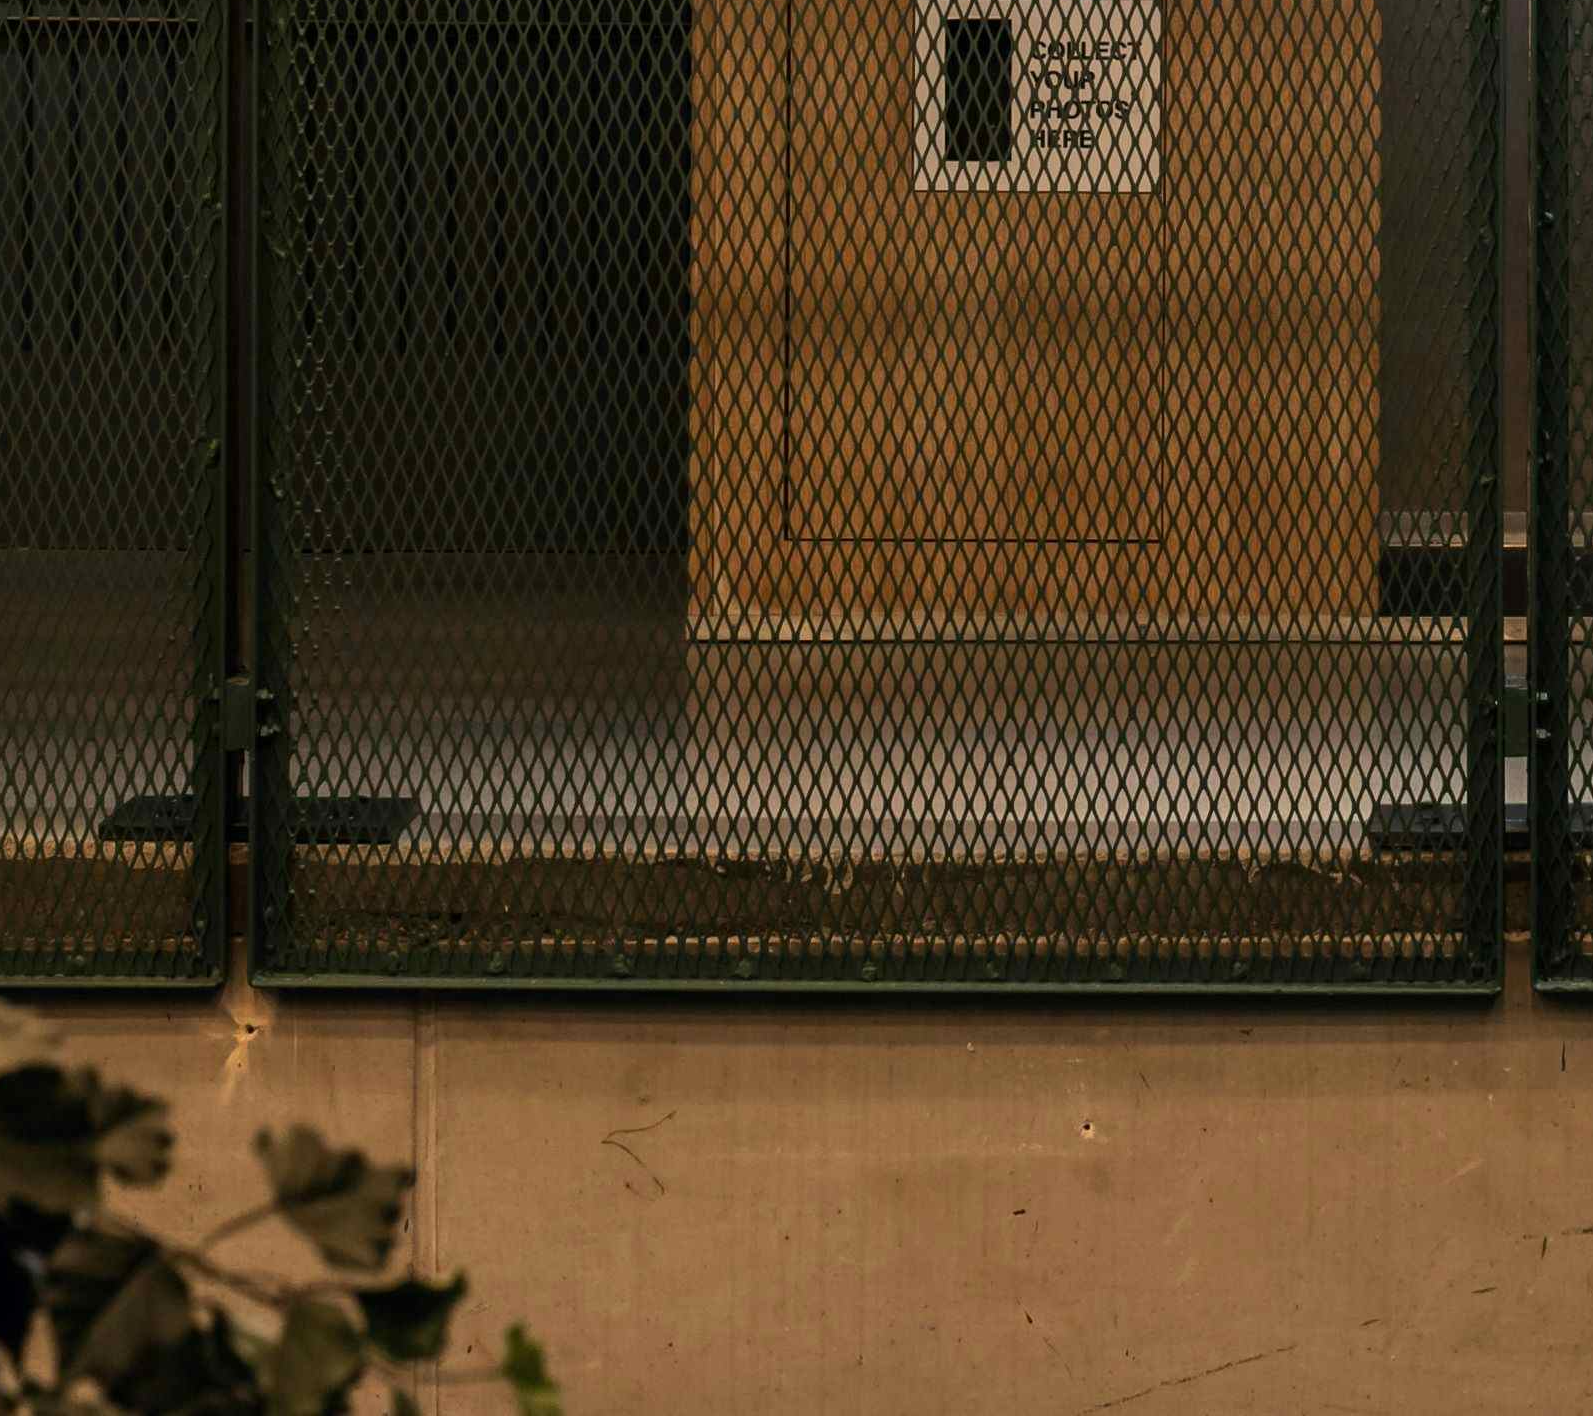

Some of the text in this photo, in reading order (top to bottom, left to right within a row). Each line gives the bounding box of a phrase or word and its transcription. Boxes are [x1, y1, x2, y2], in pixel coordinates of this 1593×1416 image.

[1031, 41, 1142, 60] COLLECT
[1031, 71, 1095, 89] YOUR
[1031, 101, 1130, 119] PHOTOS
[1031, 130, 1094, 148] HERE
